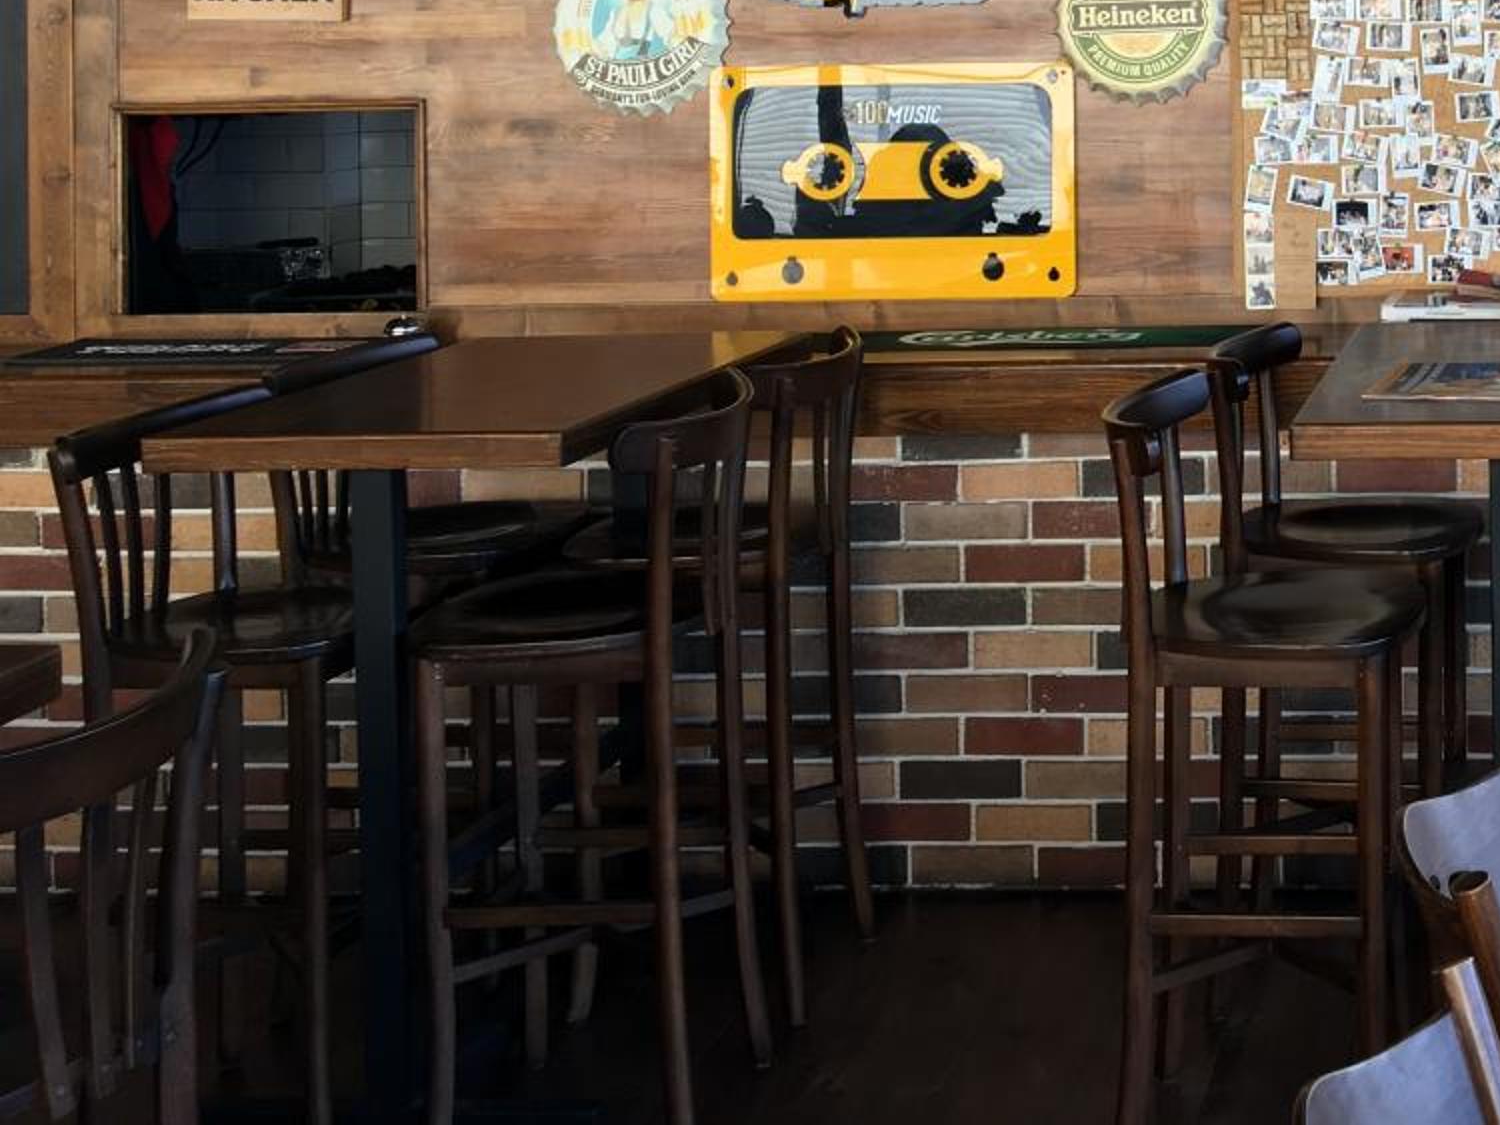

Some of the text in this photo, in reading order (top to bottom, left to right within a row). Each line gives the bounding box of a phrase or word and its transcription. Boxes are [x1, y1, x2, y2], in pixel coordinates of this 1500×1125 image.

[1077, 4, 1198, 28] Heineken
[606, 62, 660, 87] PAULI
[657, 38, 705, 77] GIRL
[1087, 41, 1190, 77] PREMIUM QUALITY
